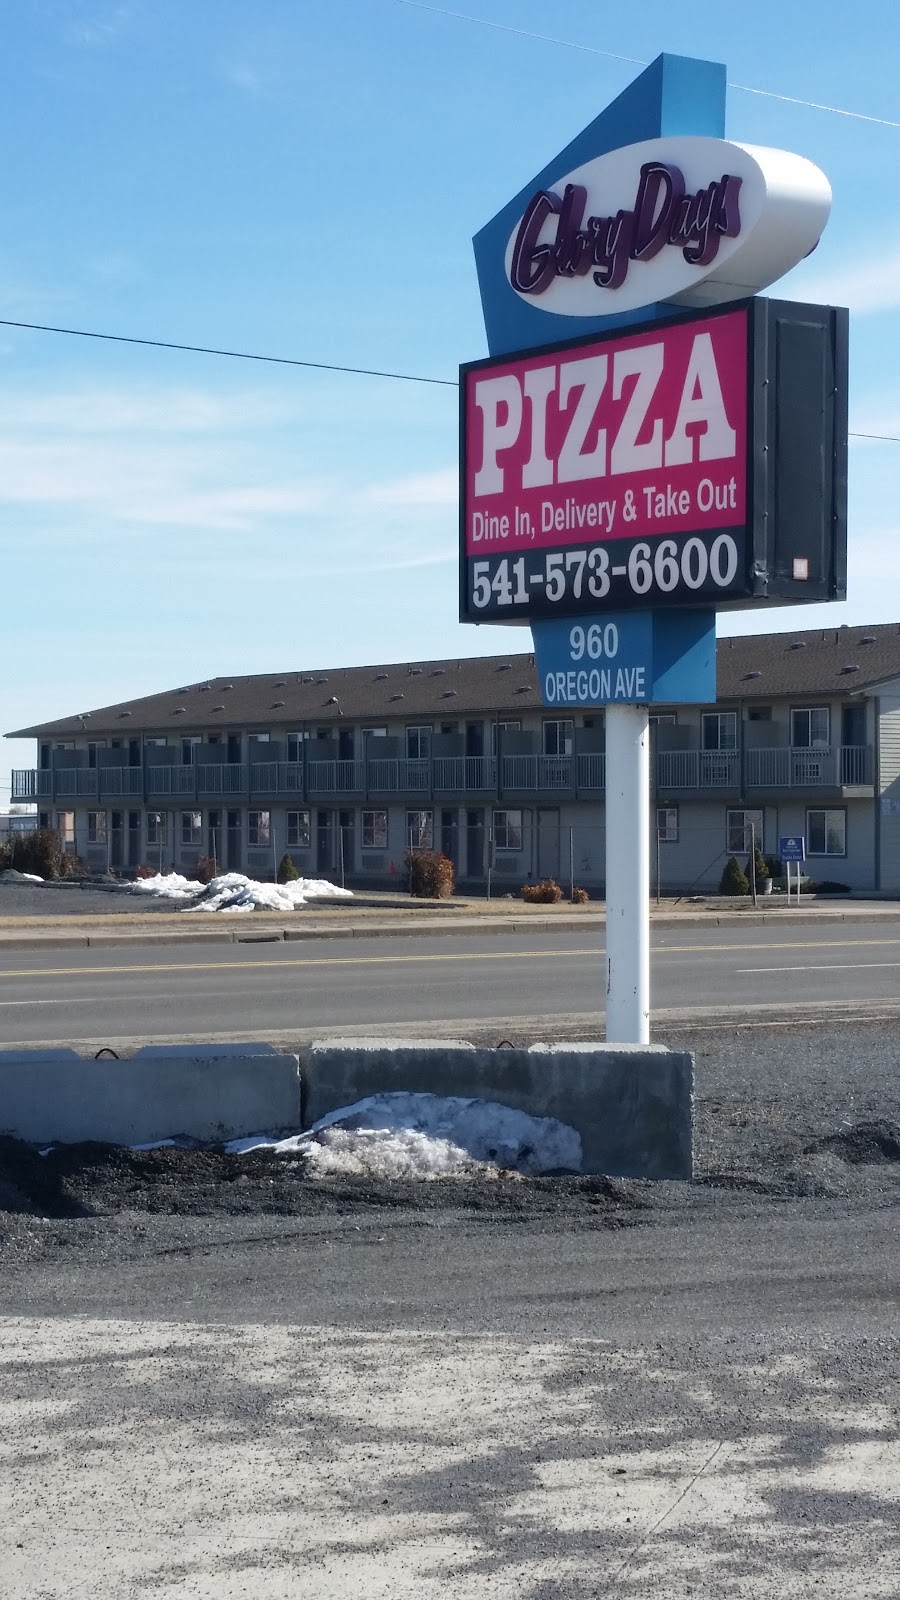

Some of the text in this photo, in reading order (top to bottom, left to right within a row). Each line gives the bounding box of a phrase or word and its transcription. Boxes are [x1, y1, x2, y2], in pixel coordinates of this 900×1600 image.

[511, 162, 743, 295] Glory Days
[474, 332, 736, 497] PIZZA
[472, 477, 737, 541] Dine In, Delivery & Take Out
[472, 534, 738, 609] 541-573-6600
[569, 623, 619, 661] 960
[545, 666, 646, 702] OREGON AVE
